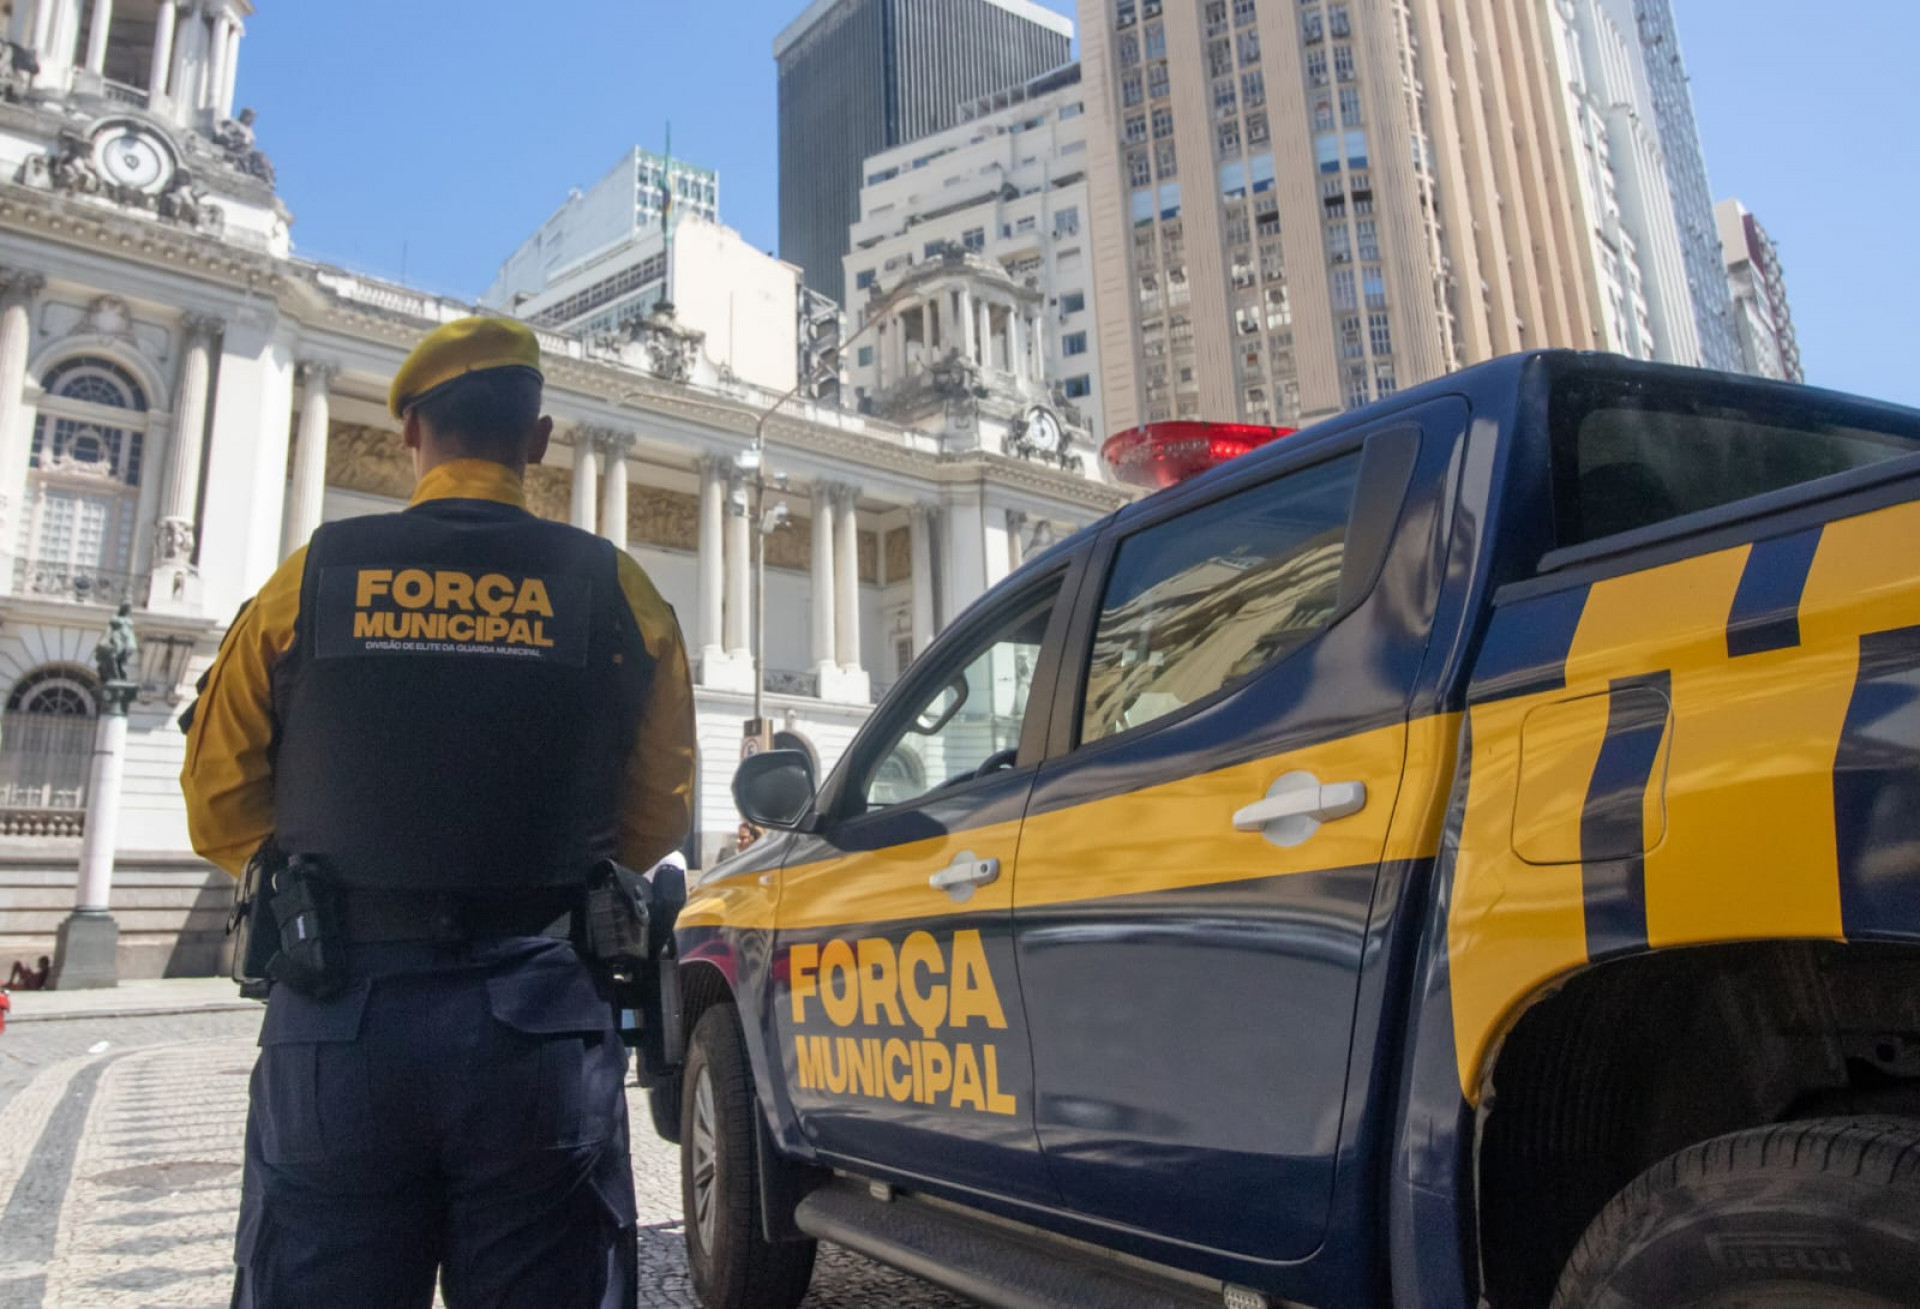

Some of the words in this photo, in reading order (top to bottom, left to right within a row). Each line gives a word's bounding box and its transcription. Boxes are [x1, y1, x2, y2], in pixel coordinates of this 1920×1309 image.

[355, 568, 554, 618] FORÇA
[353, 611, 554, 647] MUNICIPAL
[402, 641, 415, 651] DE
[415, 642, 441, 652] ELITE
[442, 642, 455, 652] DA
[456, 643, 495, 654] GUARDA
[790, 928, 1008, 1039] FORÇA
[795, 1035, 1016, 1115] MUNICIPAL
